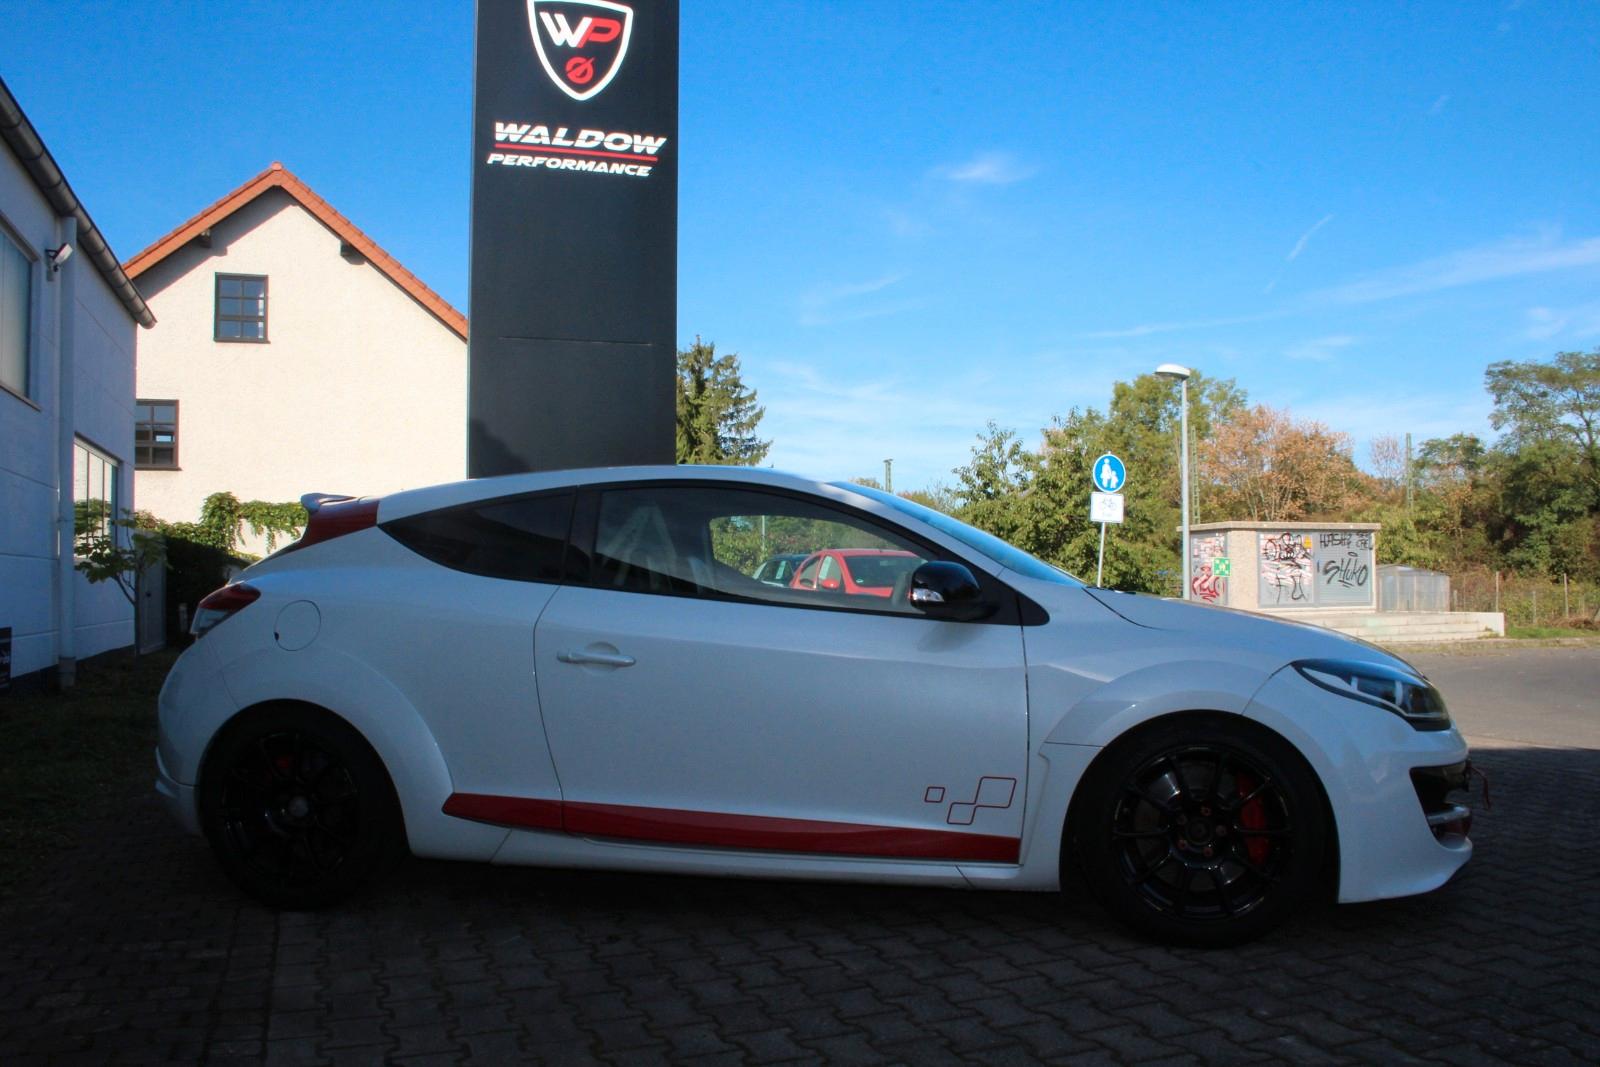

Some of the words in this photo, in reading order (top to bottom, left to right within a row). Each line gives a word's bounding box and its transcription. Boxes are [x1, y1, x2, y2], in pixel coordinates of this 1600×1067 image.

[539, 11, 622, 48] WP
[494, 122, 667, 155] WALDOW
[486, 153, 653, 177] PERFORMANCE
